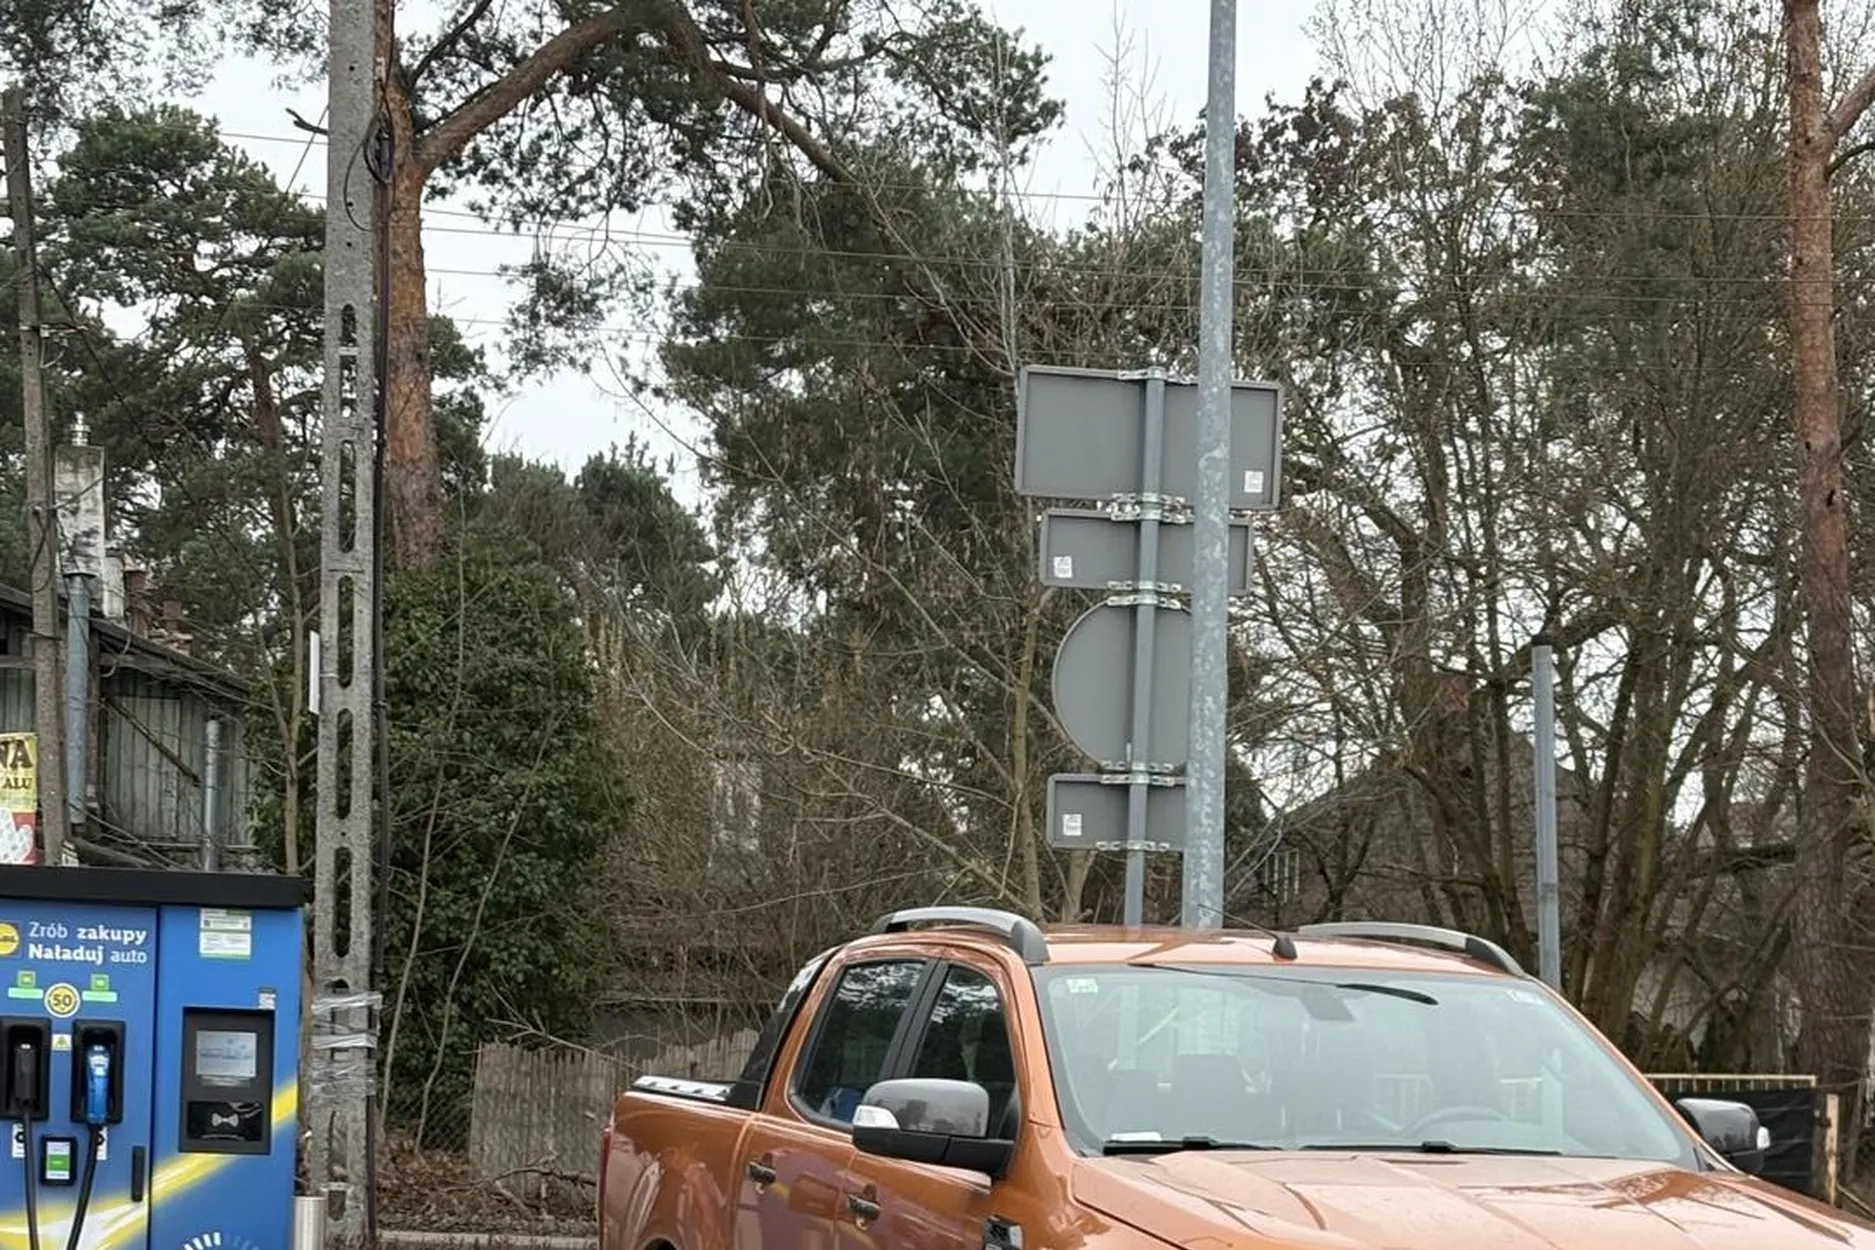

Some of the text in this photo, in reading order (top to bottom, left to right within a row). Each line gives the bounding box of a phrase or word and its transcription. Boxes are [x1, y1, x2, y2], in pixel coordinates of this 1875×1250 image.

[28, 921, 147, 945] Zrób zakupy
[28, 943, 147, 965] Naładuj auto
[53, 994, 72, 1007] 50
